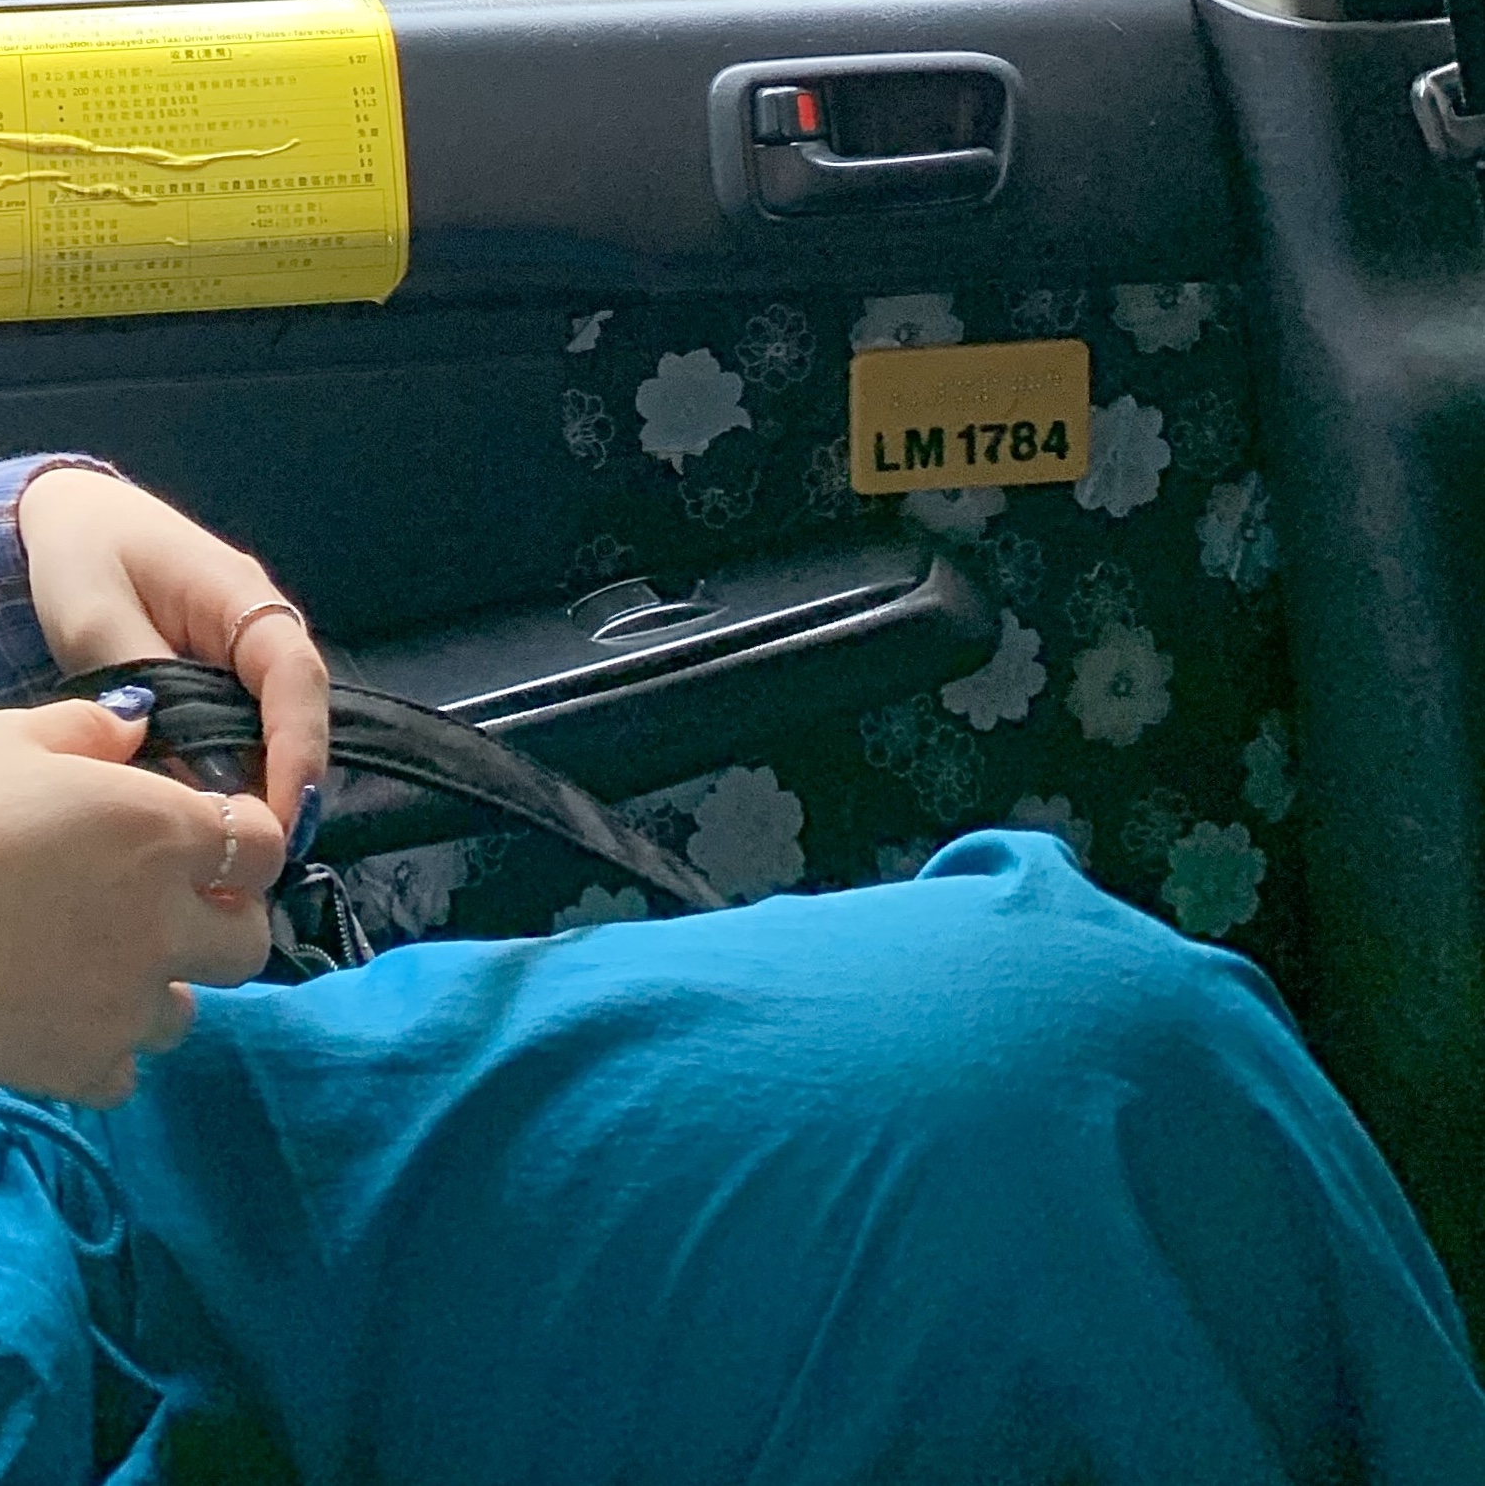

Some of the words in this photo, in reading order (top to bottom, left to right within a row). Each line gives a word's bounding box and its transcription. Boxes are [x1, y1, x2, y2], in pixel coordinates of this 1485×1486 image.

[36, 40, 93, 50] information
[96, 37, 144, 48] displayed
[185, 33, 214, 42] Driver
[874, 427, 945, 472] LM
[958, 420, 1070, 465] 1784
